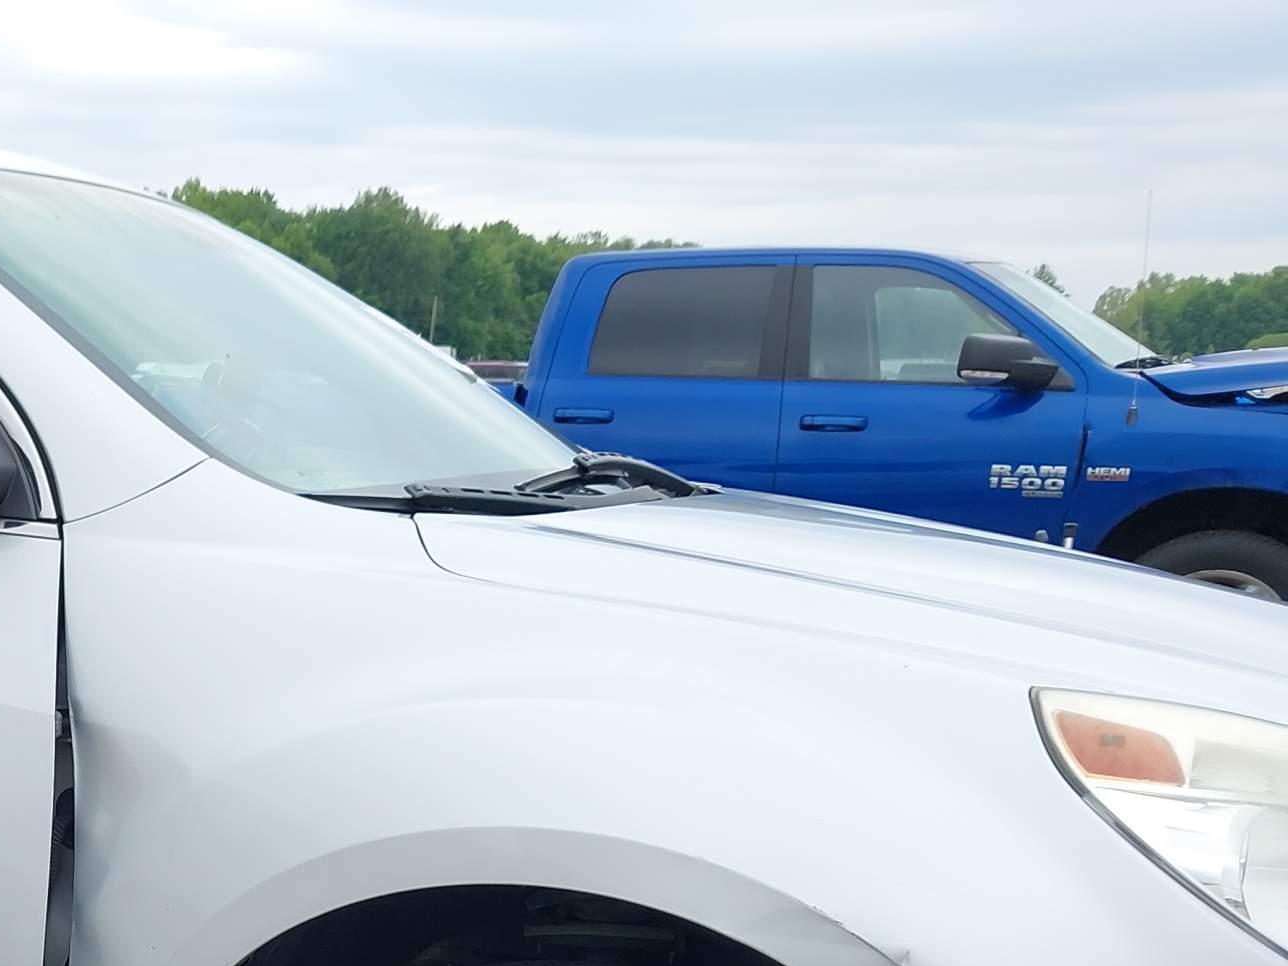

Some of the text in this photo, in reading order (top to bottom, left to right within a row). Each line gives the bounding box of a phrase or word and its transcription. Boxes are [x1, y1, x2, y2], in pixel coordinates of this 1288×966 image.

[990, 464, 1067, 478] RAM
[1087, 466, 1131, 477] HEMI
[989, 476, 1065, 490] 1500
